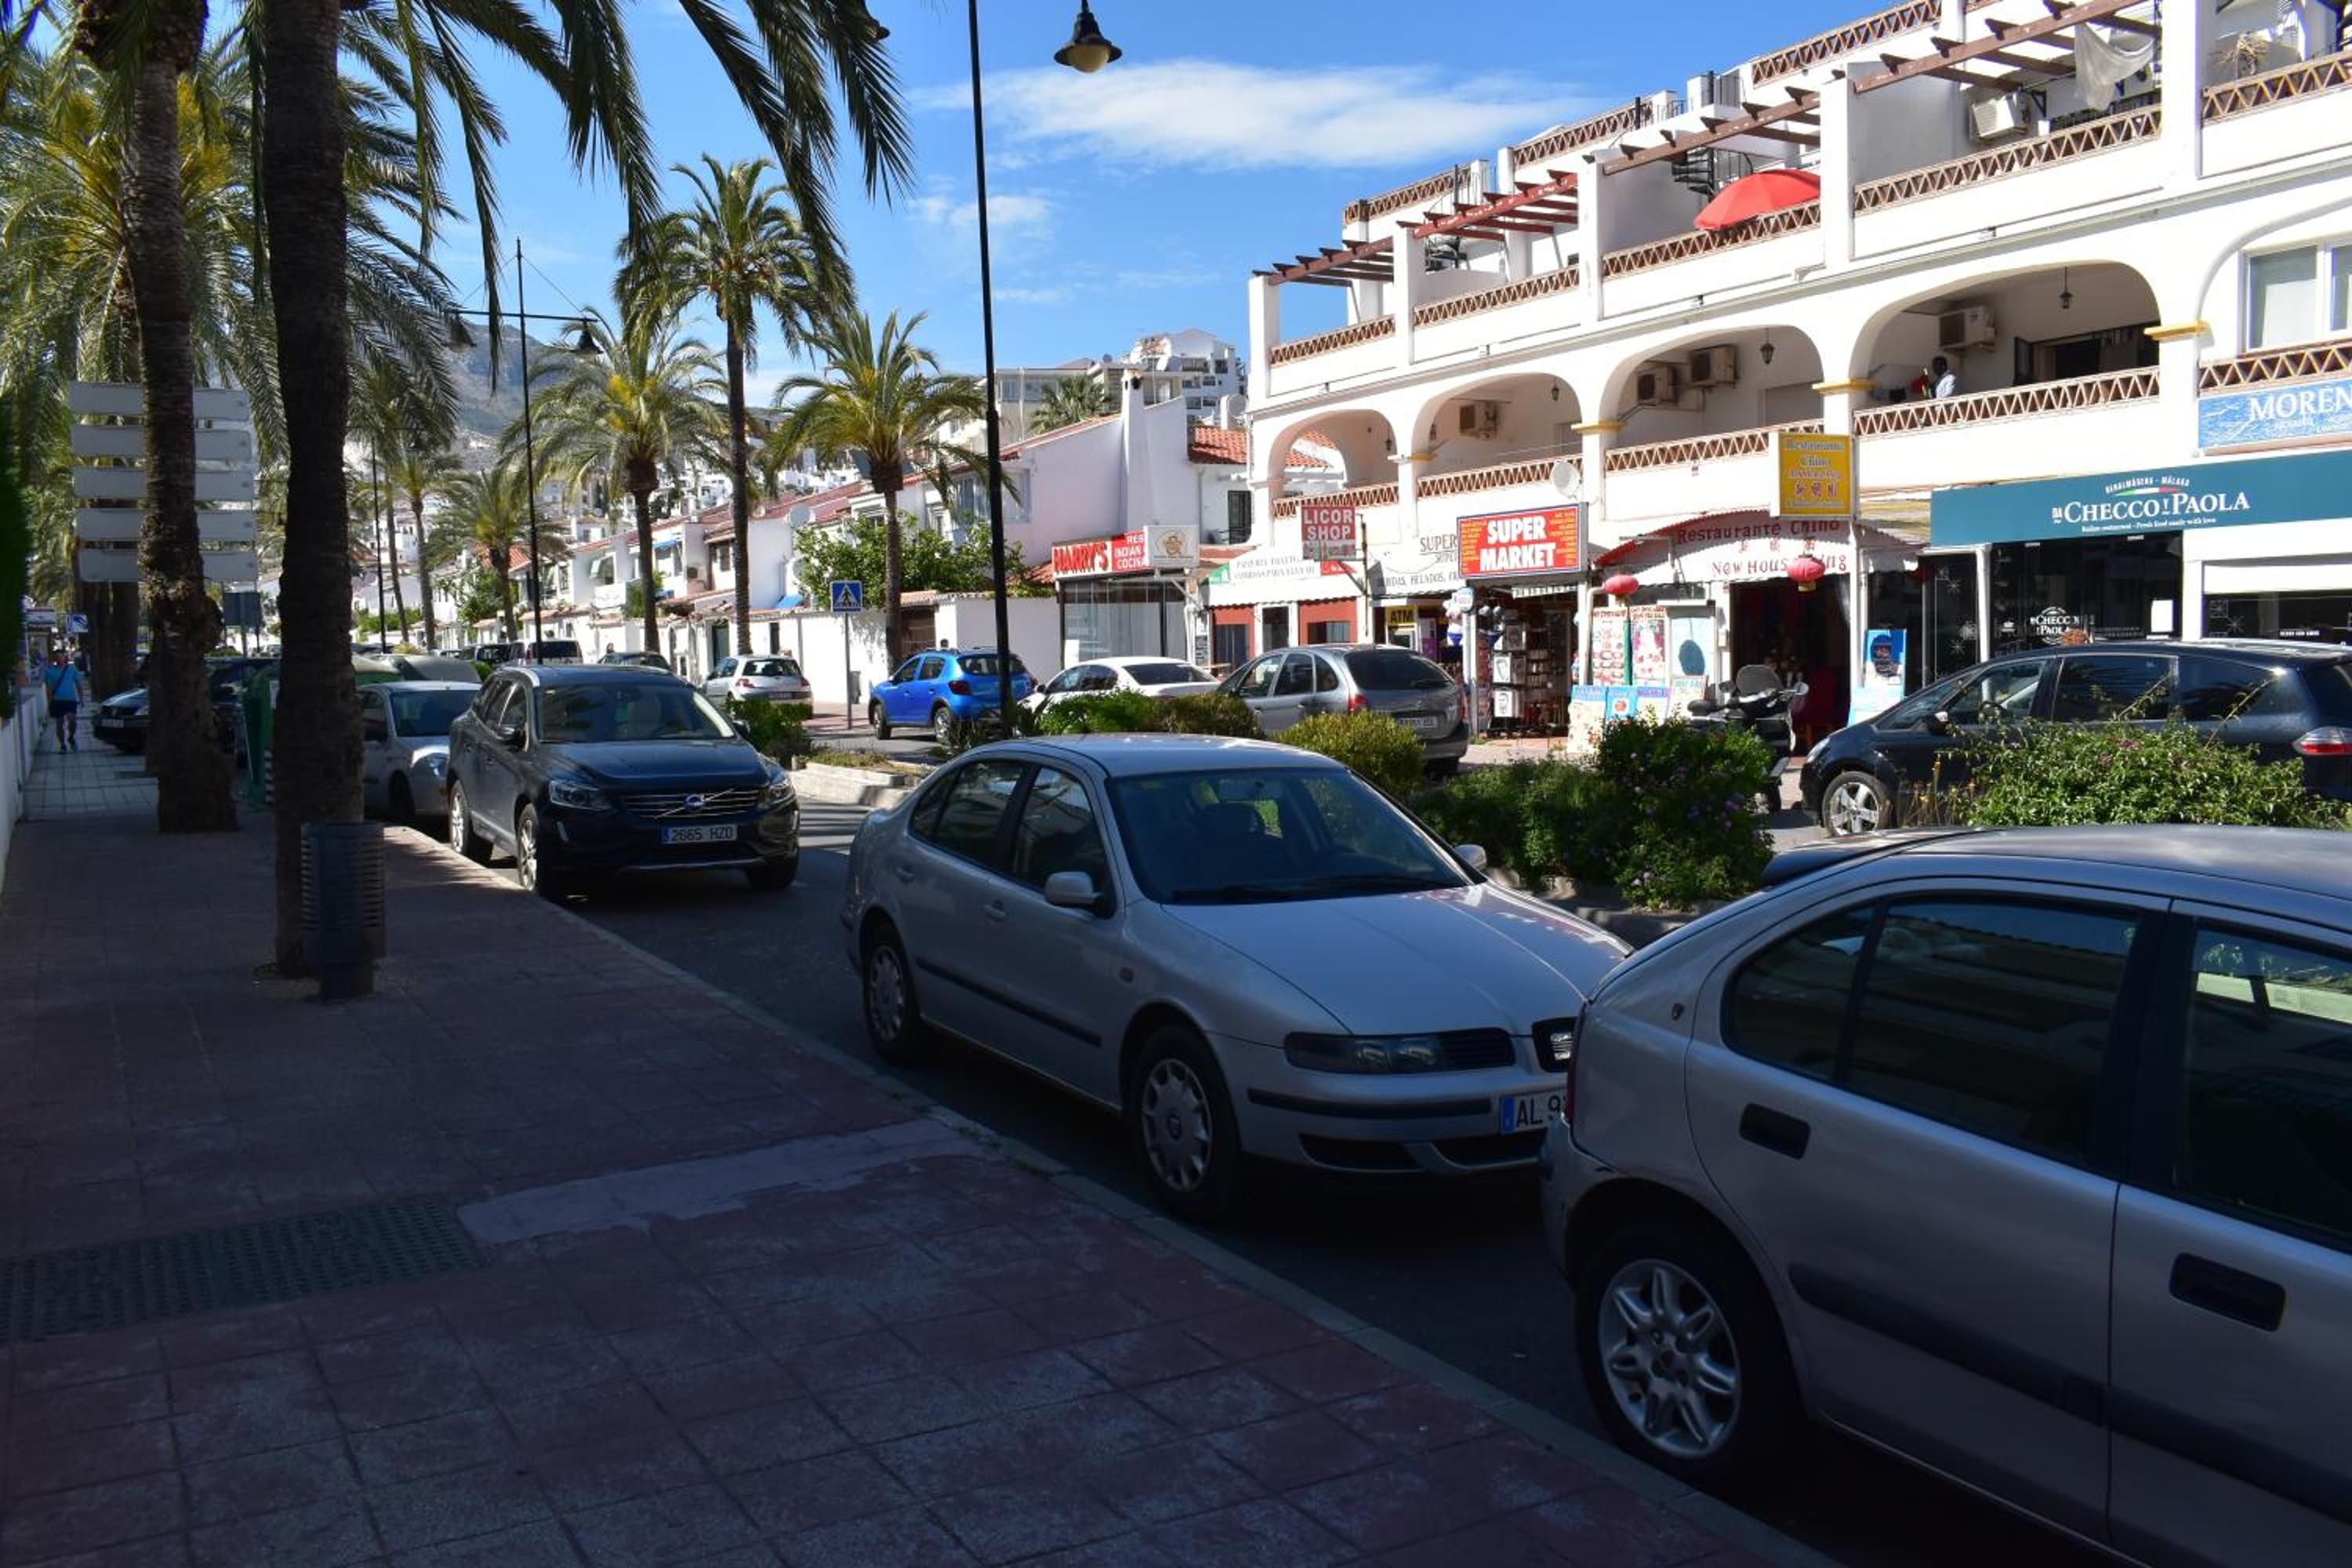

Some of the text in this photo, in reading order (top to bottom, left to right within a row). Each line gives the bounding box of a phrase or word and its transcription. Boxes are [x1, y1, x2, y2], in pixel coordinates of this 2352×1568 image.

[2161, 474, 2190, 488] MÁLAGA
[1303, 509, 1353, 524] LICOR
[1307, 525, 1351, 541] SHOP
[1486, 514, 1548, 545] SUPER
[1678, 522, 1781, 544] Restaurante
[1479, 541, 1556, 572] MARKET
[1711, 561, 1742, 575] New
[1748, 557, 1798, 573] Hous
[1390, 609, 1414, 624] ATM
[1516, 1097, 1544, 1127] AL
